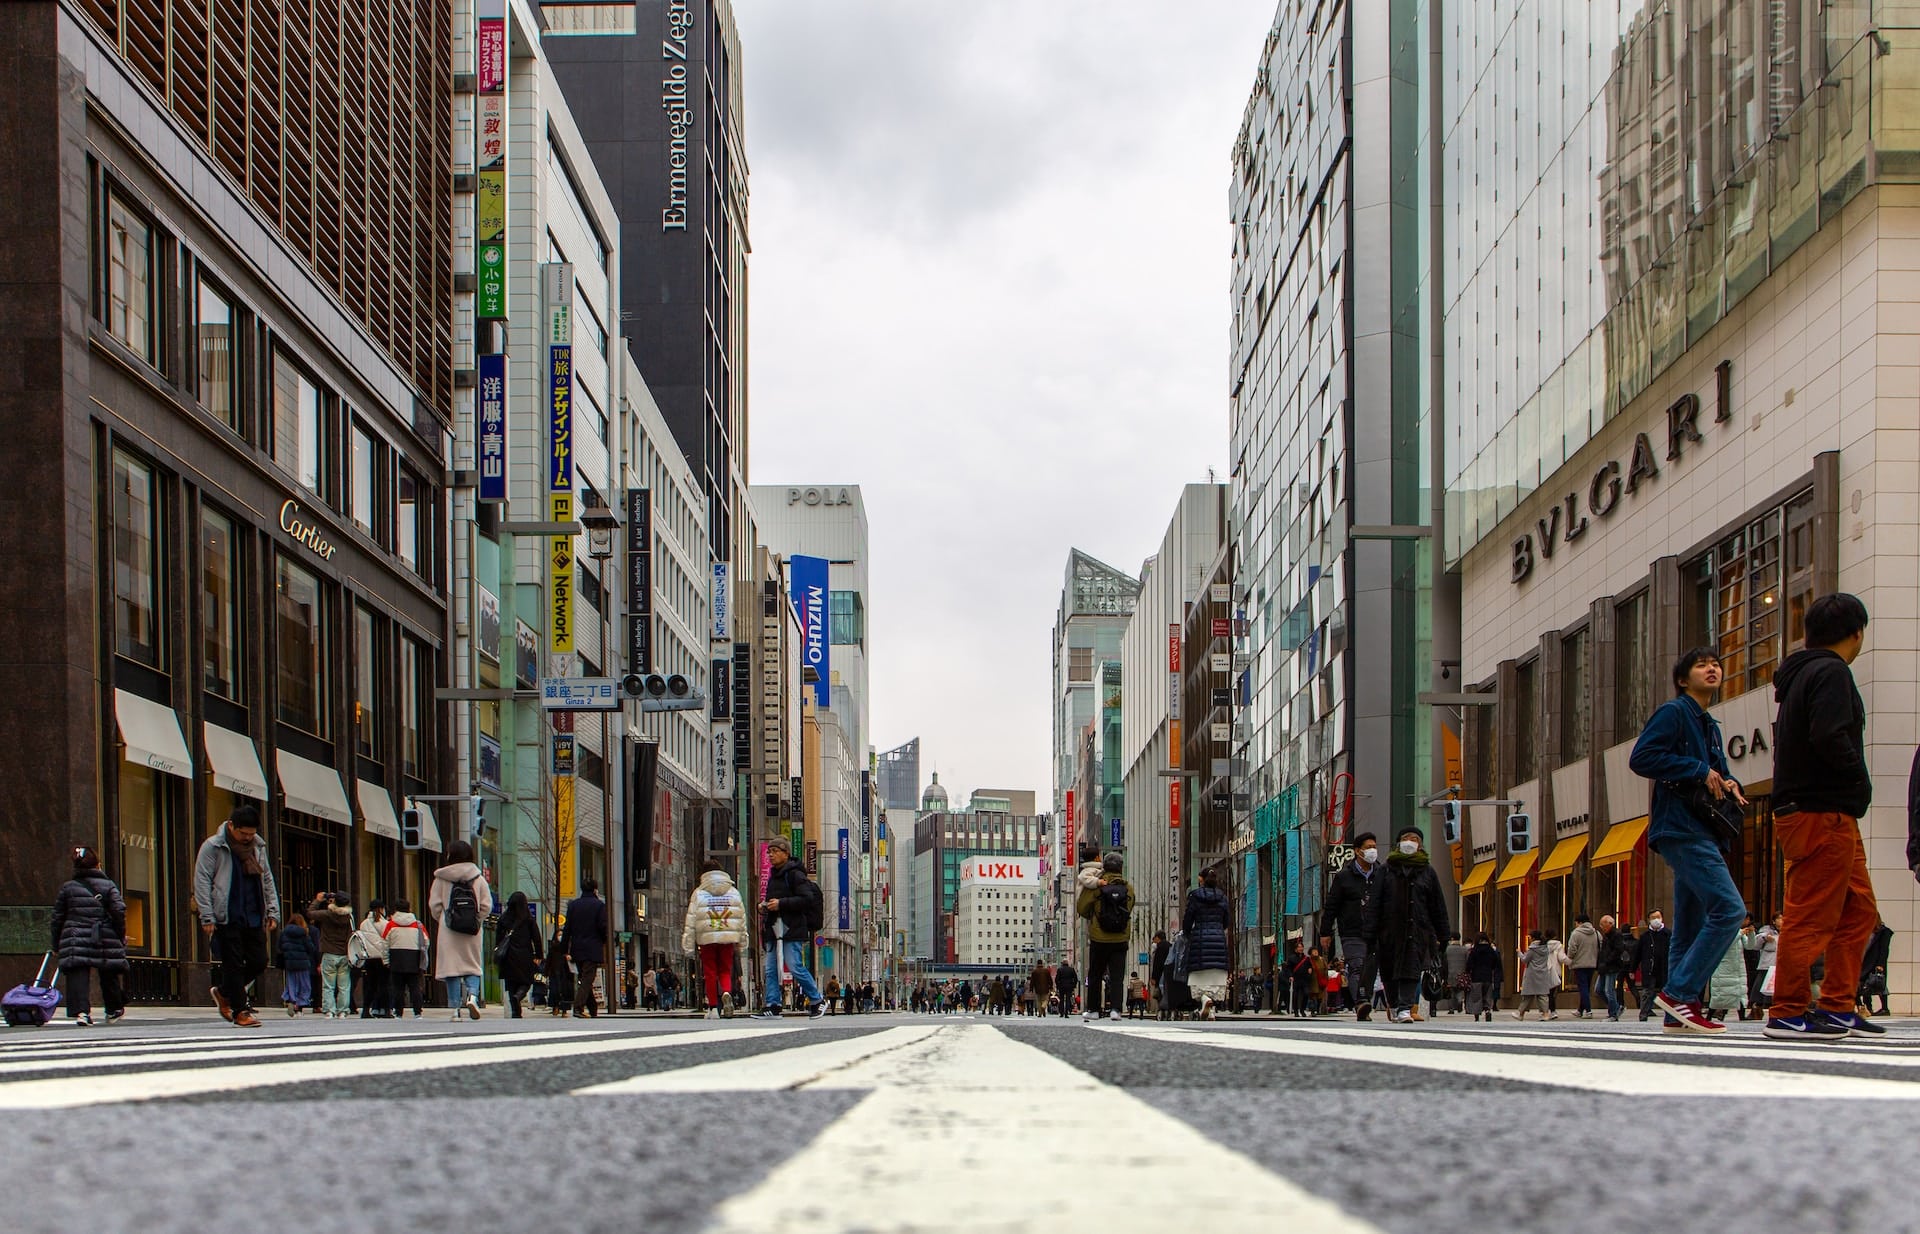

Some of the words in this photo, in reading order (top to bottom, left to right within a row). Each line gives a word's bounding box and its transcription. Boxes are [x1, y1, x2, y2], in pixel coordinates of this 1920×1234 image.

[482, 32, 491, 88] ゴルフスクール
[662, 64, 694, 232] Ermenegildo
[485, 268, 499, 312] 小肥羊
[482, 377, 503, 477] 洋服の青山
[1510, 359, 1732, 584] BVLGARI
[788, 488, 852, 506] POLA
[279, 499, 336, 561] Cartier
[635, 527, 643, 540] List
[807, 585, 823, 664] MIZUHO
[636, 652, 644, 664] List
[545, 686, 612, 698] 銀座二丁目
[147, 753, 174, 772] Cartier
[231, 779, 253, 794] Cartier
[978, 863, 1024, 879] LIXIL
